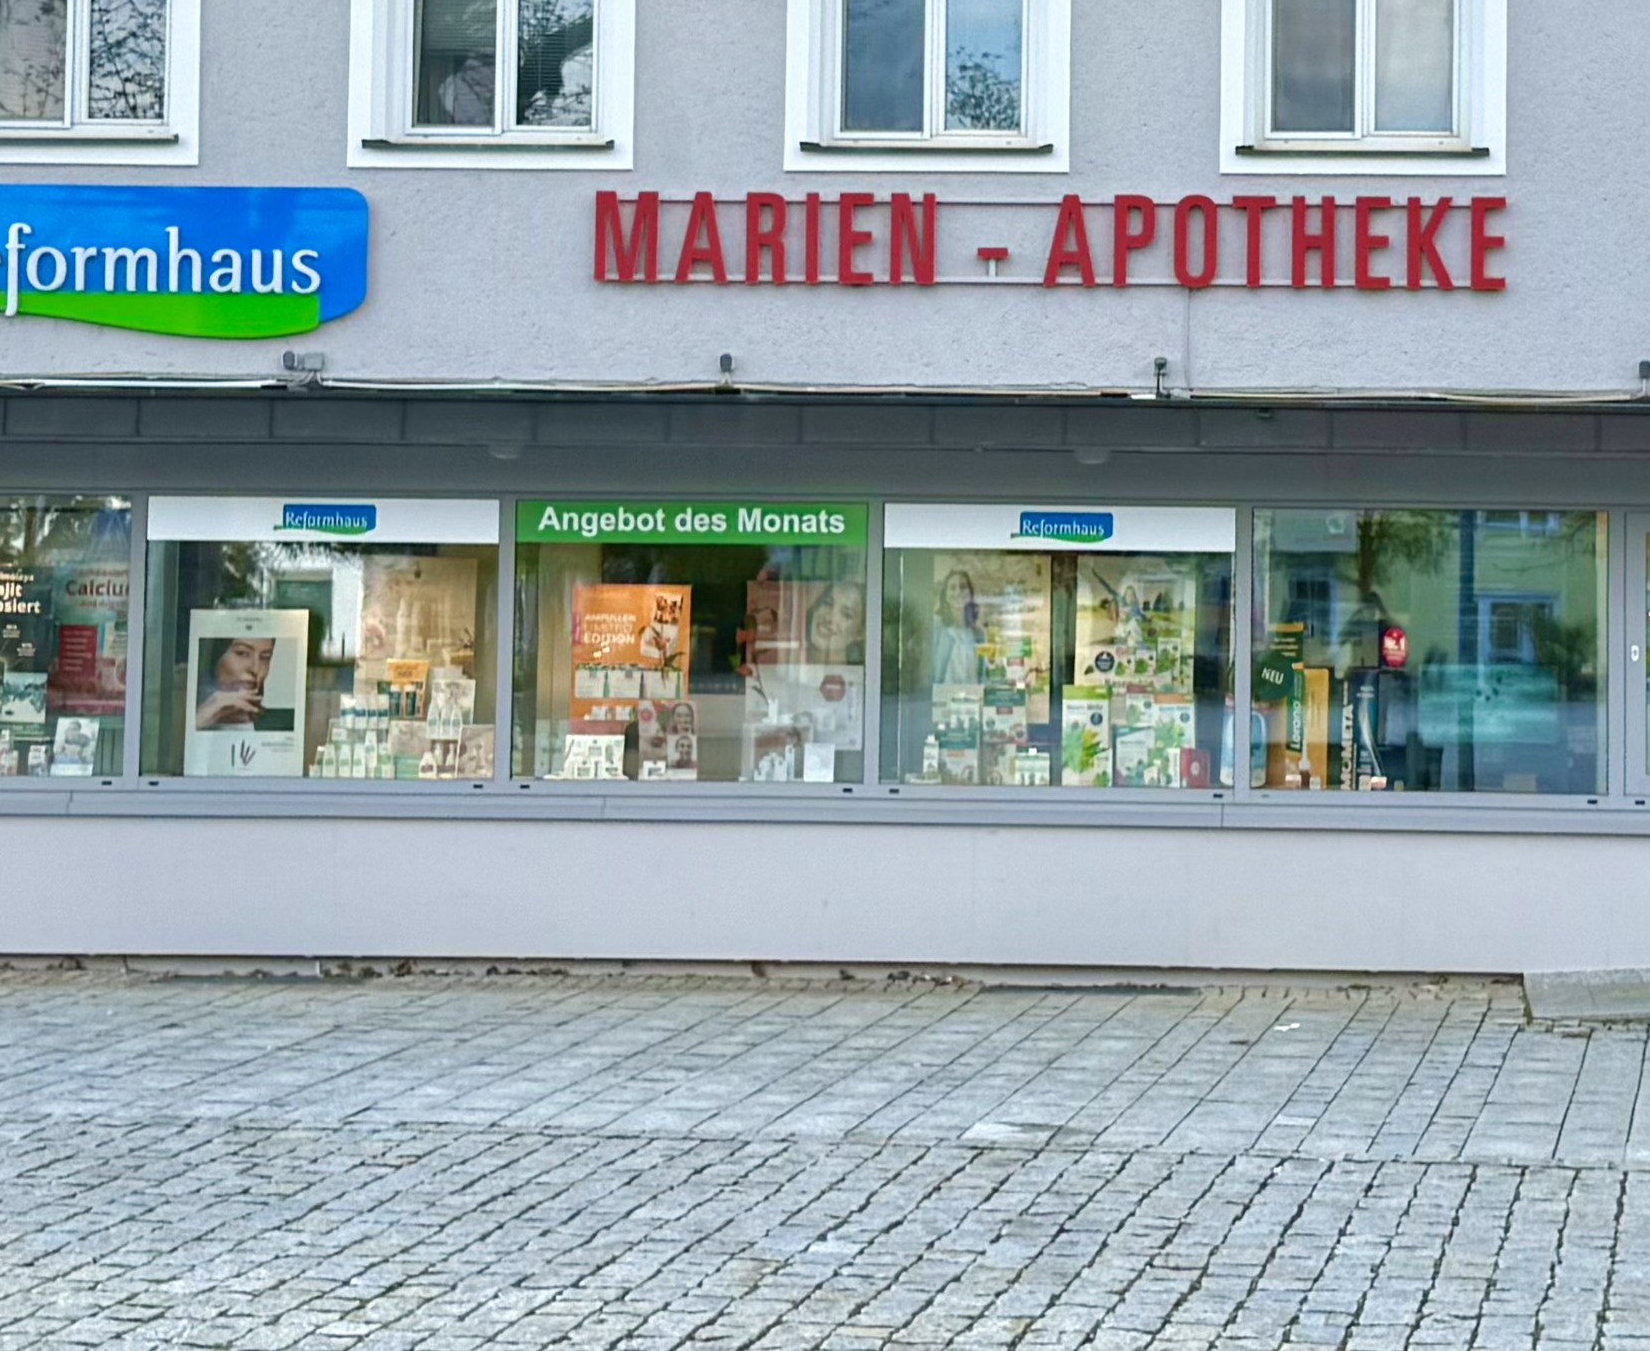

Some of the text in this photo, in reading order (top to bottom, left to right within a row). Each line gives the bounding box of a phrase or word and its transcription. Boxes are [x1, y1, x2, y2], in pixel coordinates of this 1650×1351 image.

[594, 189, 937, 286] MARIEN
[1042, 193, 1509, 292] APOTHEKE
[285, 510, 368, 530] Reformhaus
[537, 506, 846, 538] Angebot des Monats
[1022, 518, 1105, 538] Reformhaus
[1261, 667, 1285, 685] NEU
